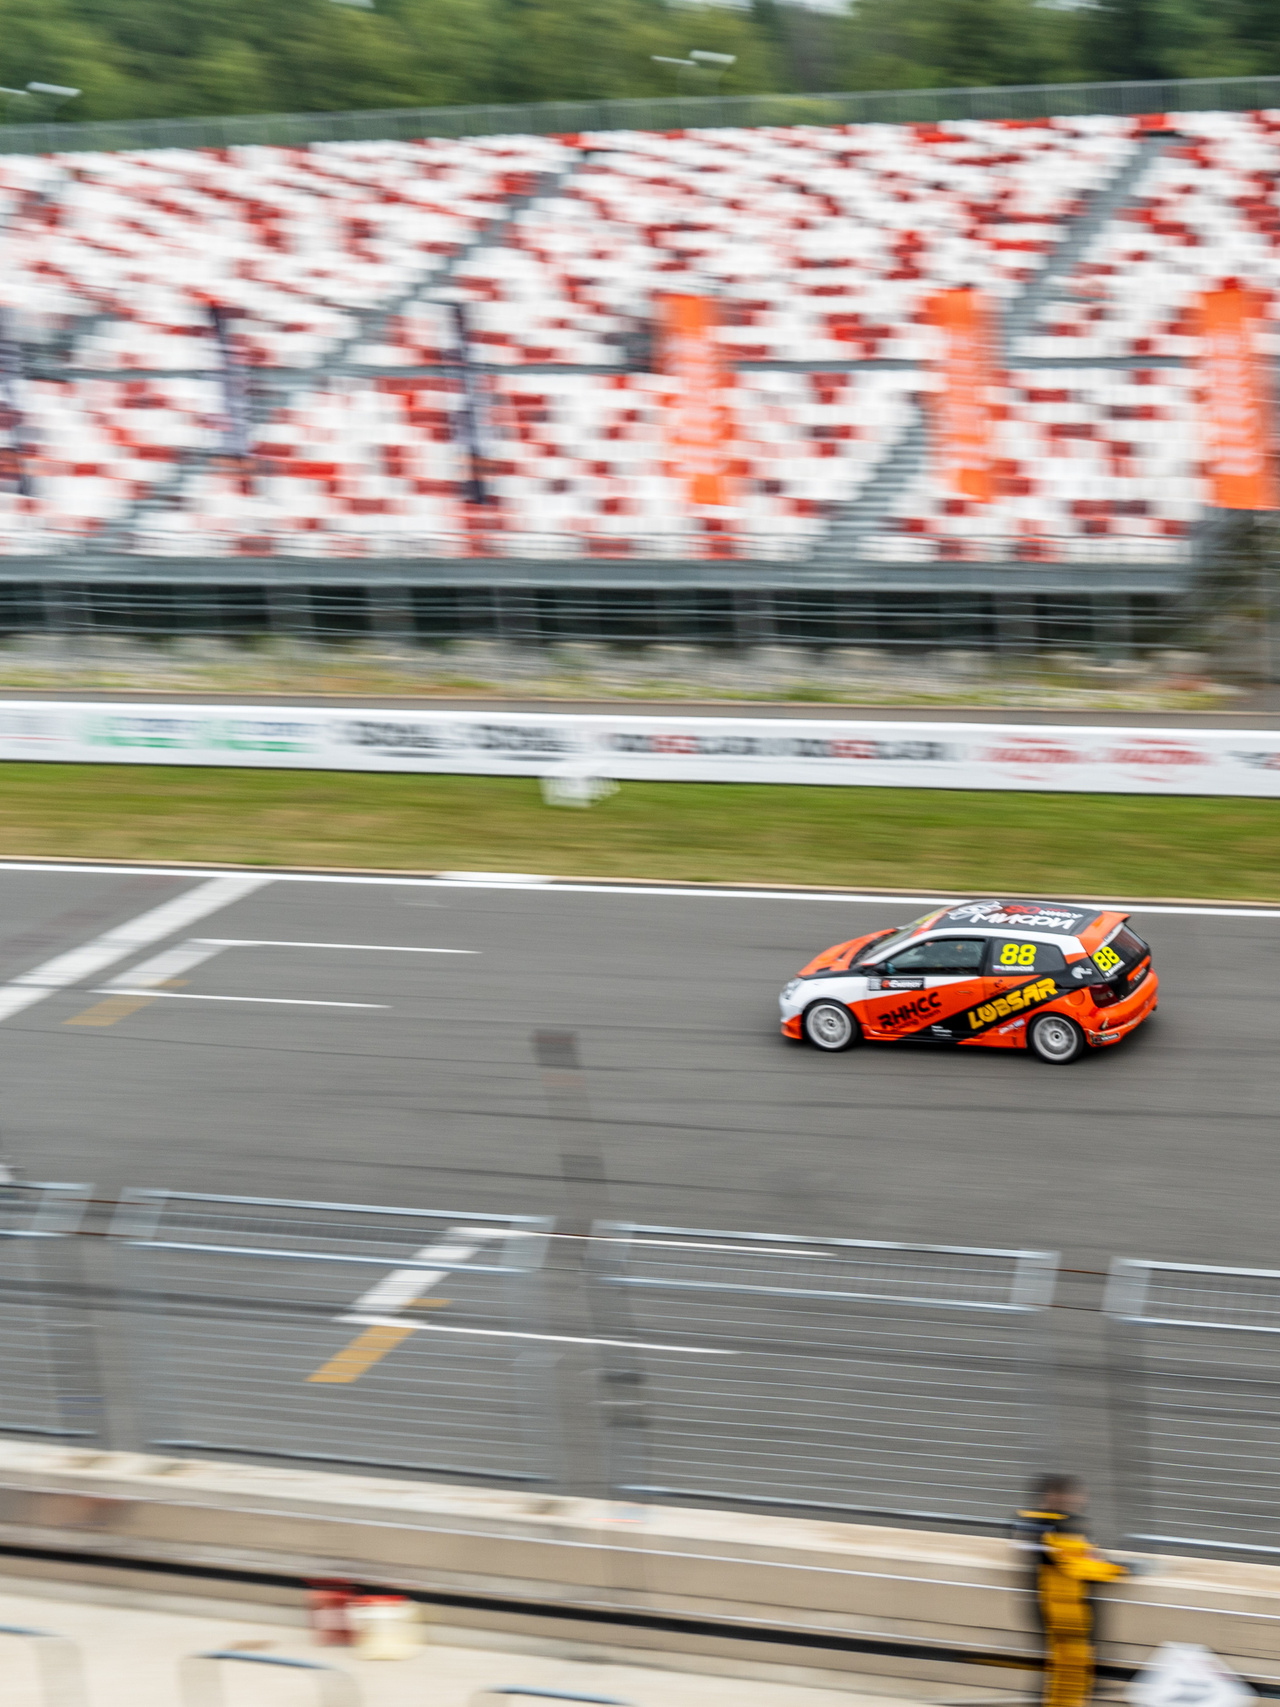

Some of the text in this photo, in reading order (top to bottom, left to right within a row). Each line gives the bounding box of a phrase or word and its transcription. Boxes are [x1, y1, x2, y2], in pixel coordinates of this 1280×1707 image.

[1000, 943, 1037, 965] 88
[1093, 946, 1120, 972] 88
[878, 992, 942, 1029] RHHCC
[967, 977, 1059, 1030] LUBSAR
